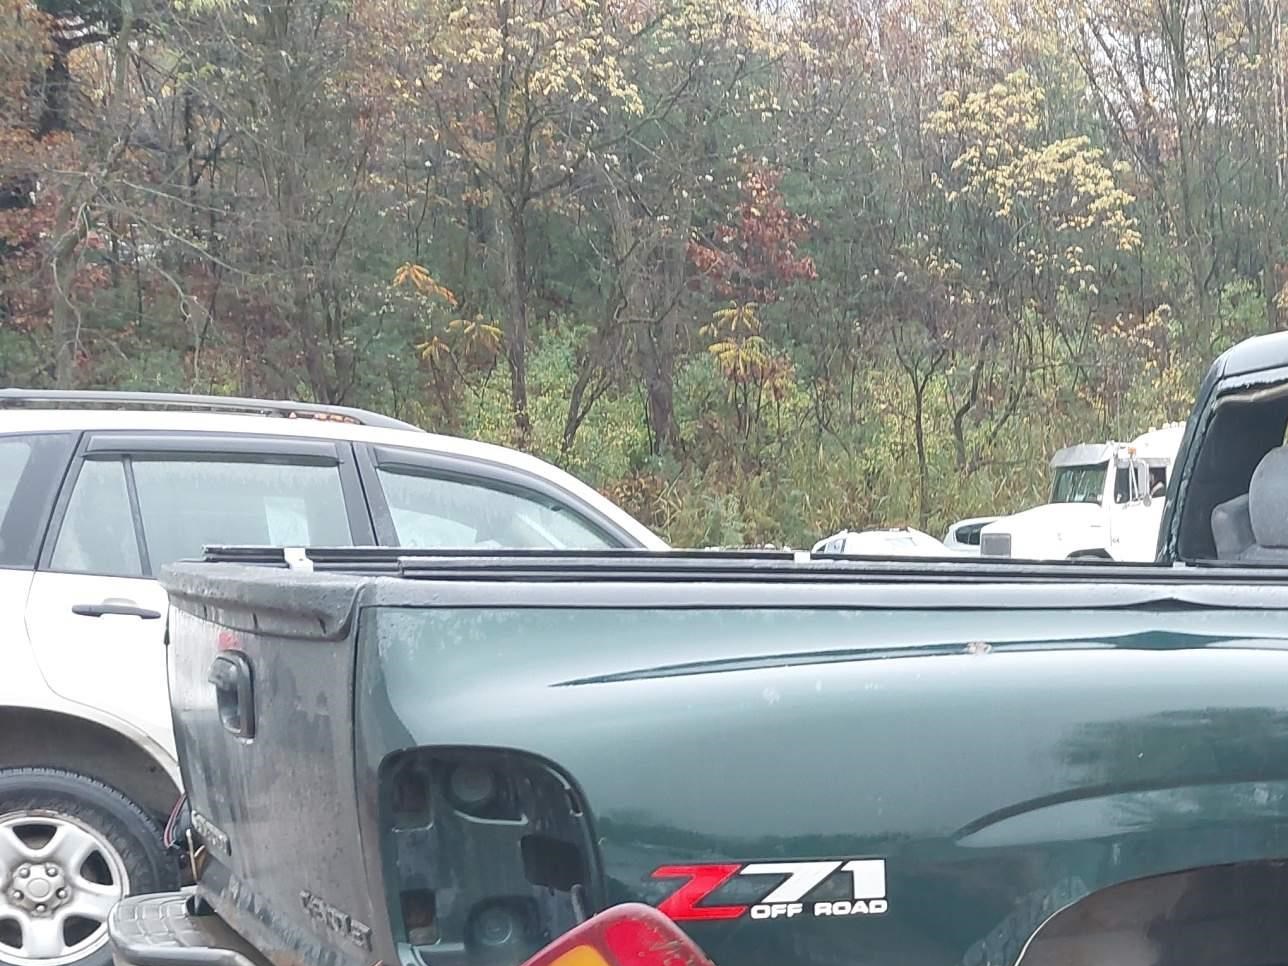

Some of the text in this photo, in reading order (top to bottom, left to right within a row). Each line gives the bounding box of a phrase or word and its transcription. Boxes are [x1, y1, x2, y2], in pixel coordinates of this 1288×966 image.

[650, 858, 886, 922] Z71
[750, 899, 887, 919] OFF ROAD
